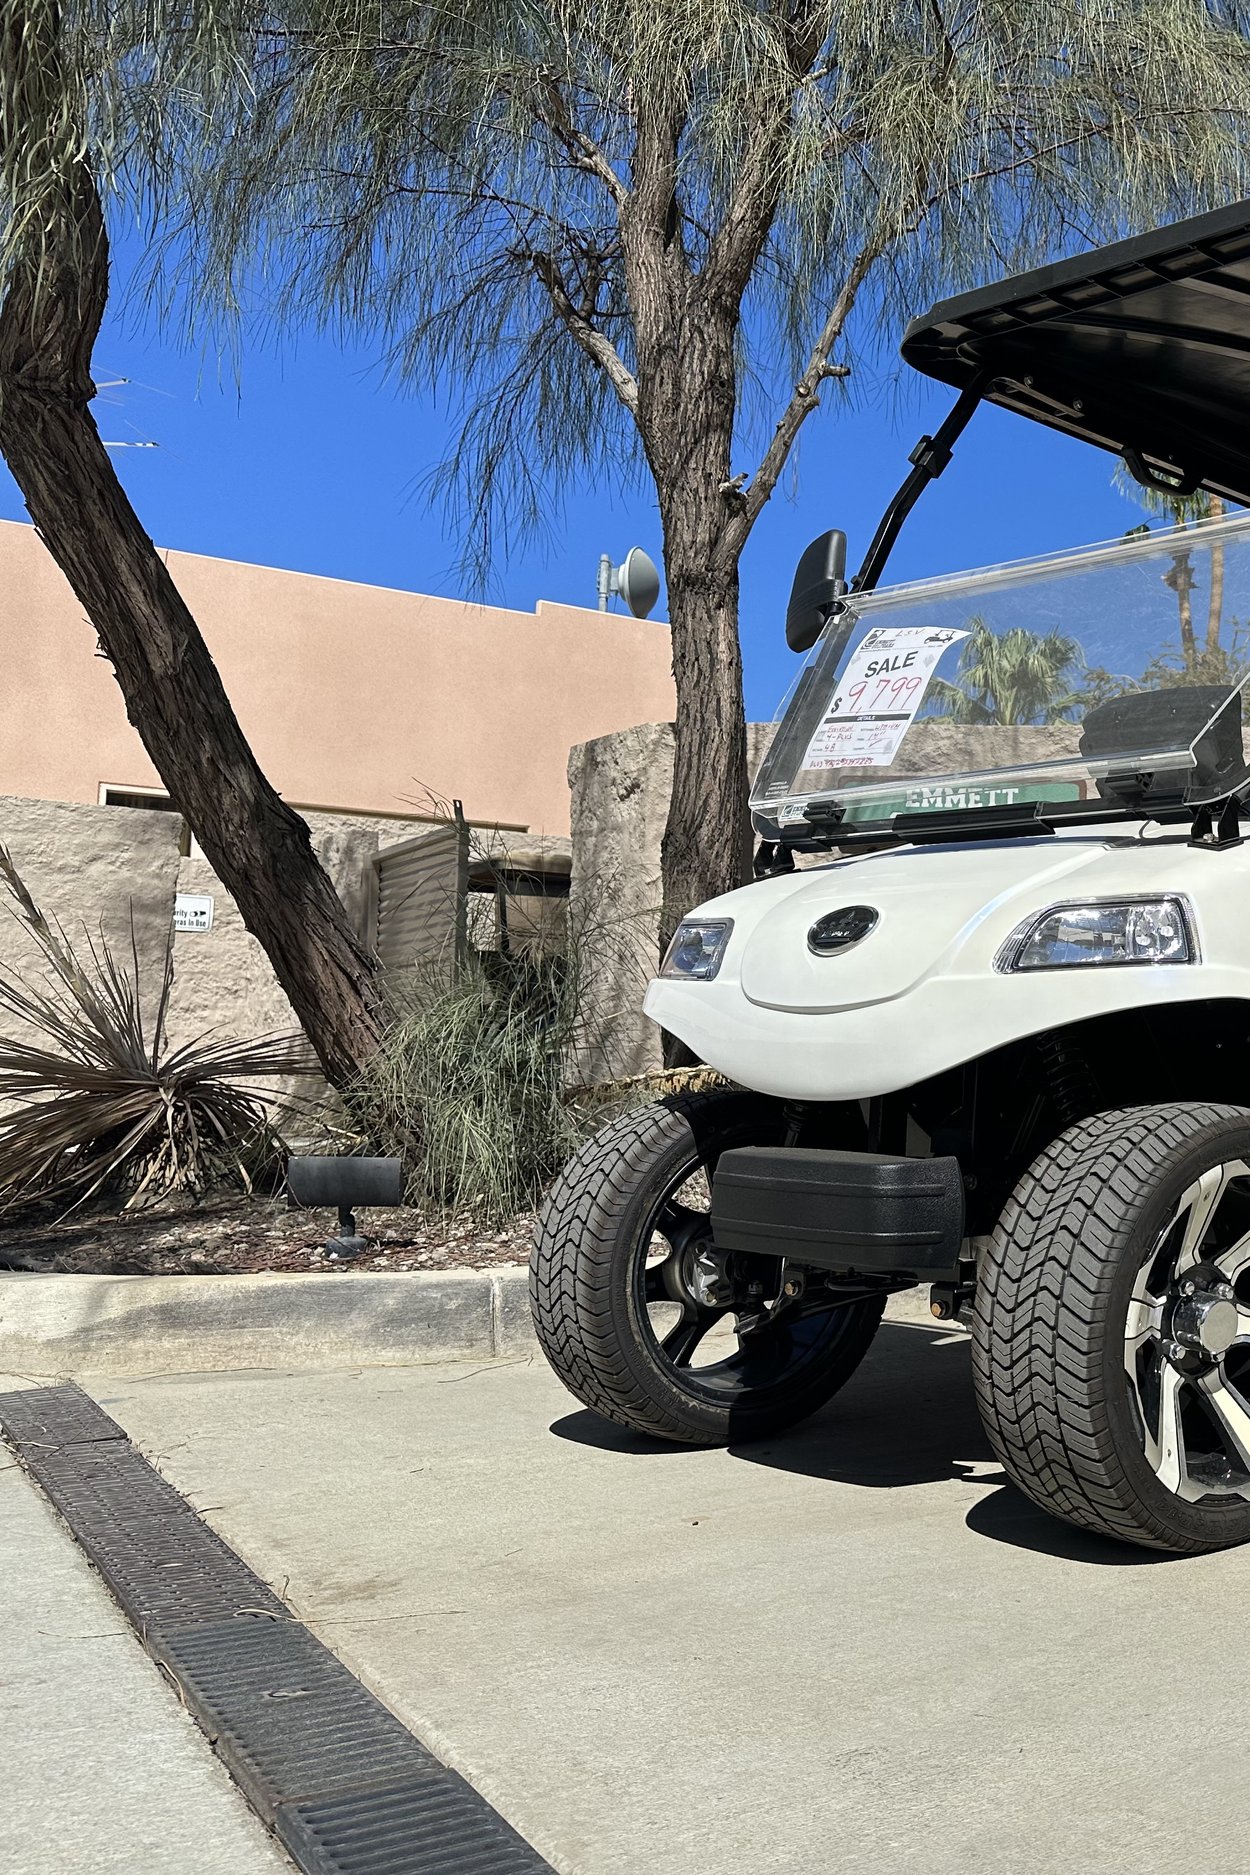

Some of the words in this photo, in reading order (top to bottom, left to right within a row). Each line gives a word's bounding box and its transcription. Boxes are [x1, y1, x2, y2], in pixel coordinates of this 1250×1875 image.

[864, 651, 918, 678] SALE
[831, 697, 842, 713] $
[849, 677, 922, 714] 9,799
[906, 788, 1019, 808] EMMETT
